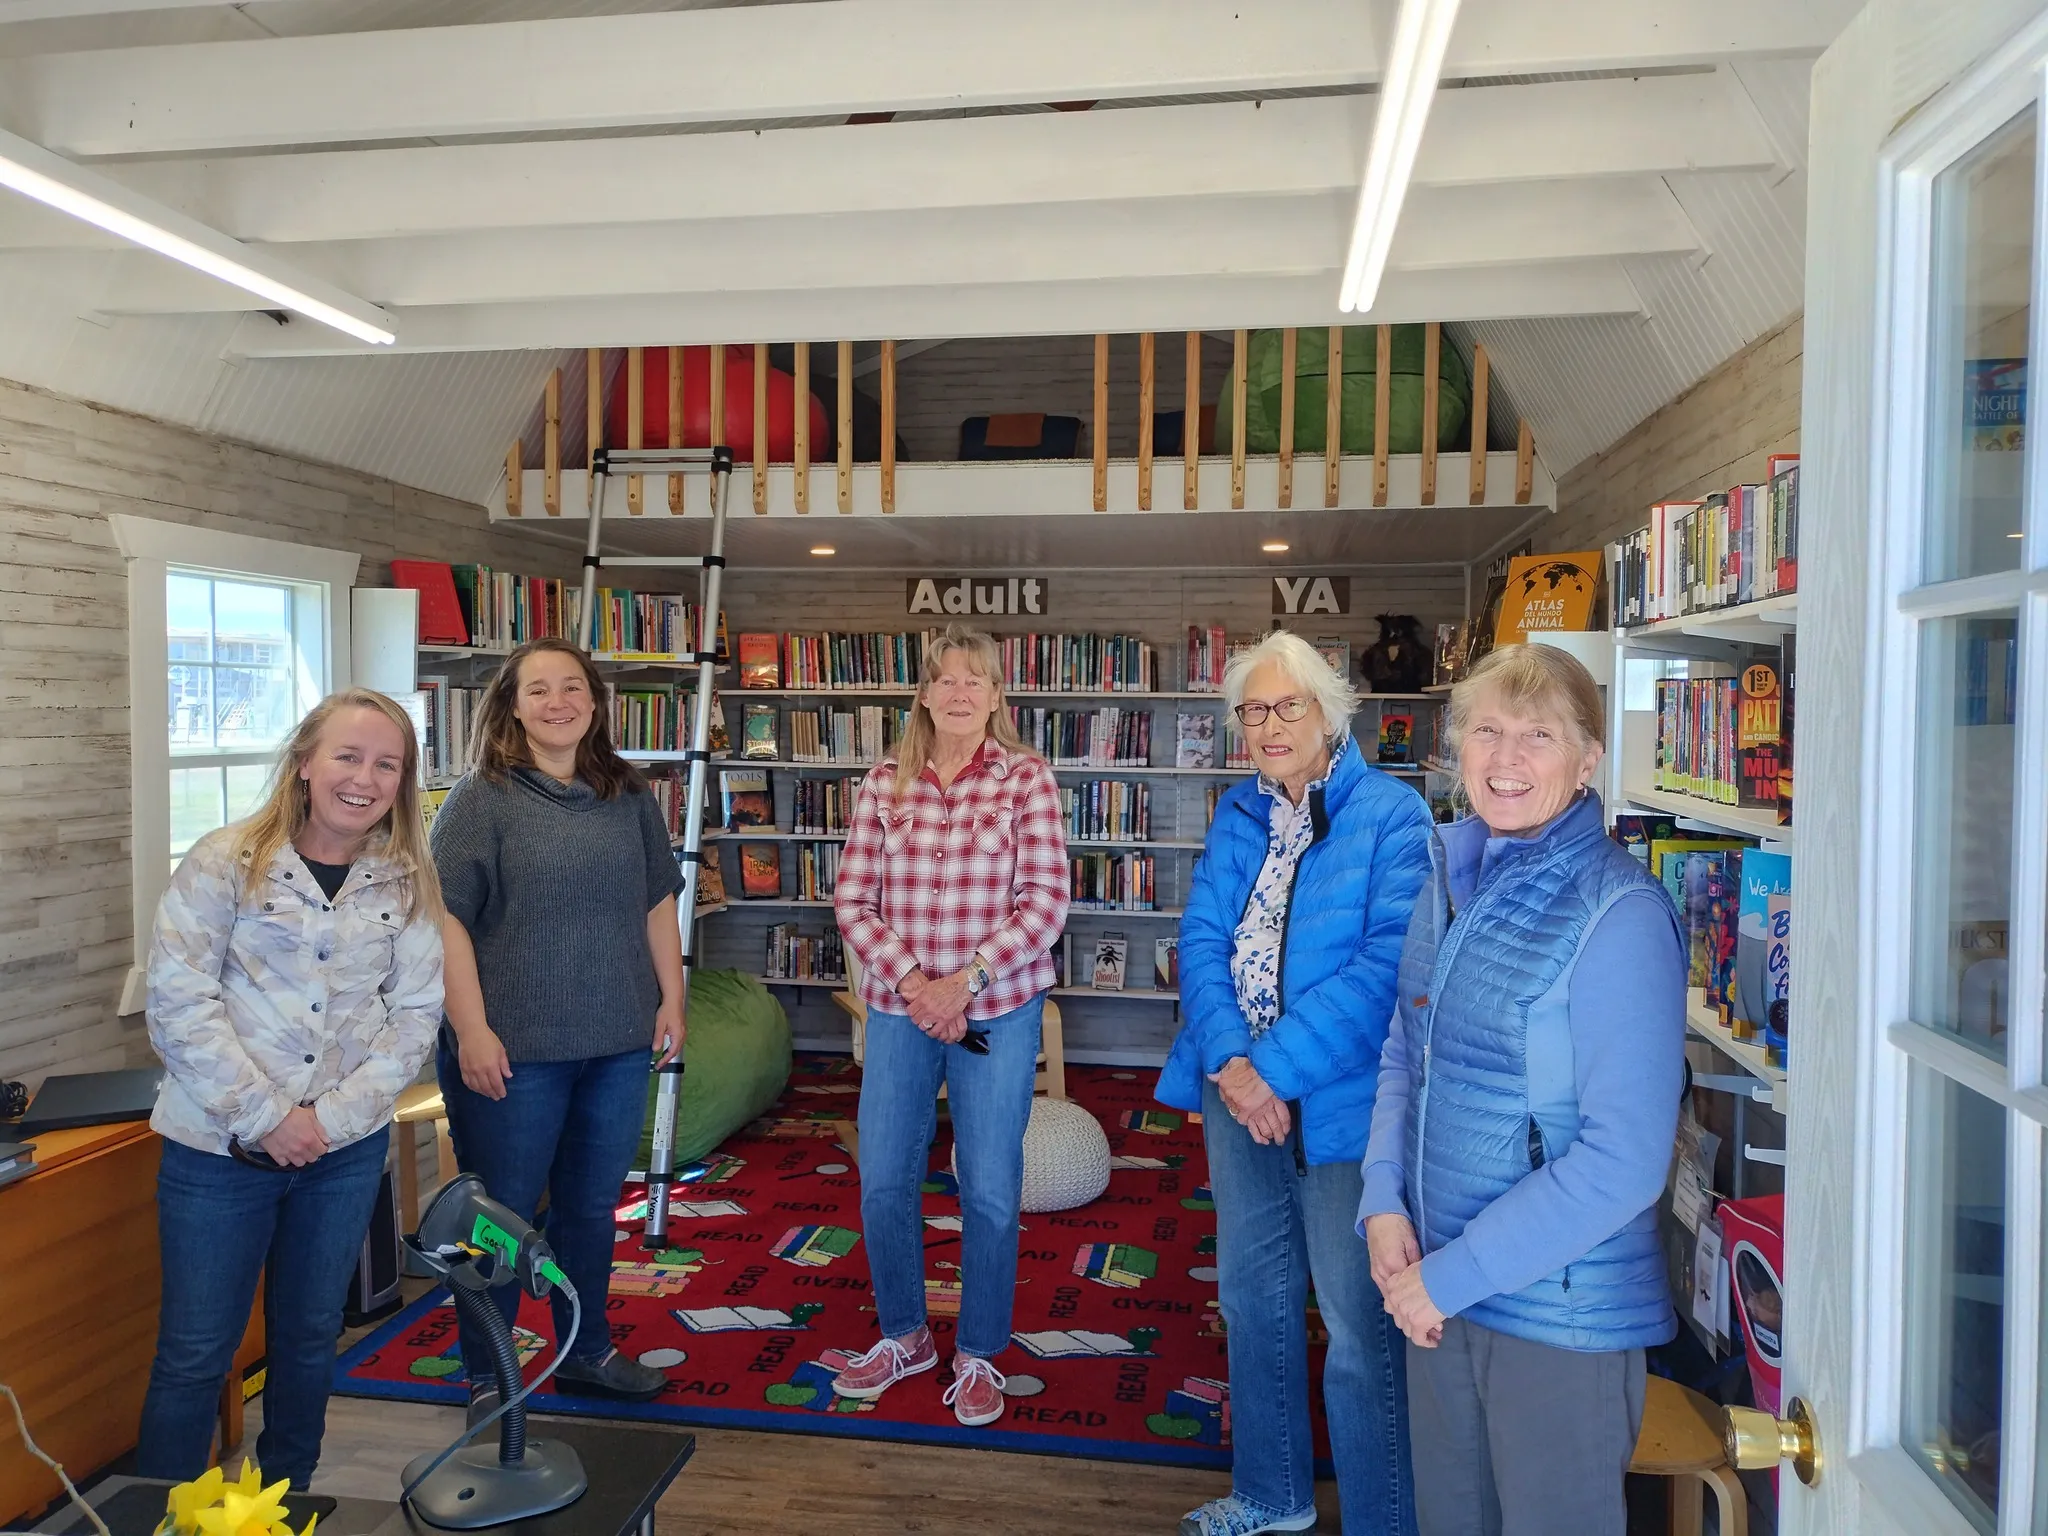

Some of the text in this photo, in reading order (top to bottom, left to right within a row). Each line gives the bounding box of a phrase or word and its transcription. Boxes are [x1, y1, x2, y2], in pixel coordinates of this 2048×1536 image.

[1972, 395, 2019, 412] NIGHT
[909, 578, 1040, 614] Adult
[1274, 577, 1340, 613] YA
[1524, 599, 1565, 611] ATLAS
[1516, 616, 1565, 629] ANIMAL
[1749, 669, 1770, 692] 1ST
[1756, 748, 1772, 757] THE
[1755, 779, 1778, 800] IN
[749, 860, 772, 869] IRON
[749, 869, 774, 877] FLAME
[1748, 876, 1768, 897] We
[695, 892, 720, 902] CLIMB
[1771, 909, 1790, 939] B
[1768, 942, 1790, 973] Co
[772, 1201, 839, 1214] READ
[1049, 1216, 1120, 1231] READ
[1153, 1216, 1178, 1242] READ
[691, 1230, 764, 1243] READ
[724, 1265, 769, 1297] READ
[792, 1274, 870, 1290] READ
[1048, 1285, 1082, 1319] READ
[1112, 1296, 1193, 1314] READ
[747, 1335, 796, 1373] READ
[664, 1379, 731, 1396] EAD
[1115, 1362, 1150, 1403] READ
[1012, 1406, 1107, 1427] READ
